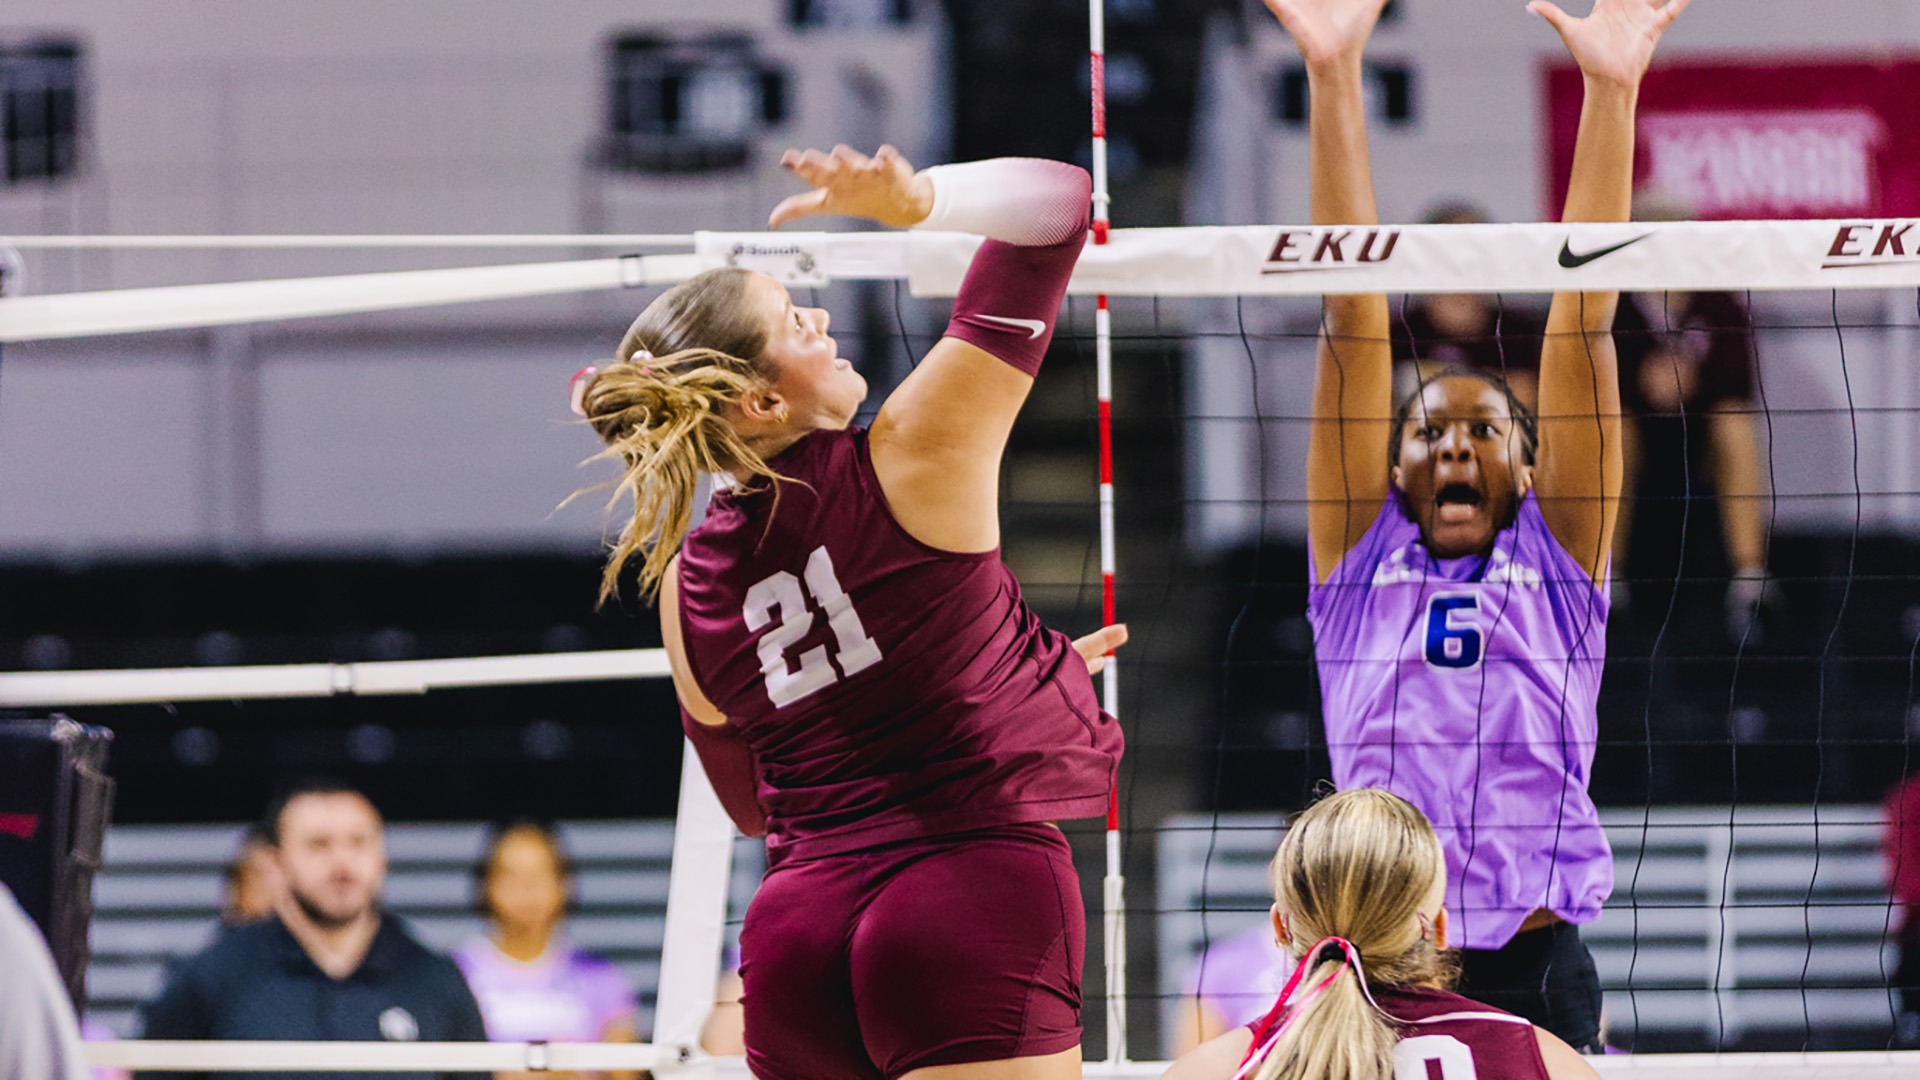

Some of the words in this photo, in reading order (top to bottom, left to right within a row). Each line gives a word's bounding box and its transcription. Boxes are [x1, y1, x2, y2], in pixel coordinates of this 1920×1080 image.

[1265, 230, 1401, 262] EKU
[1826, 225, 1920, 256] EK
[742, 544, 883, 709] 21
[1422, 590, 1484, 670] 6
